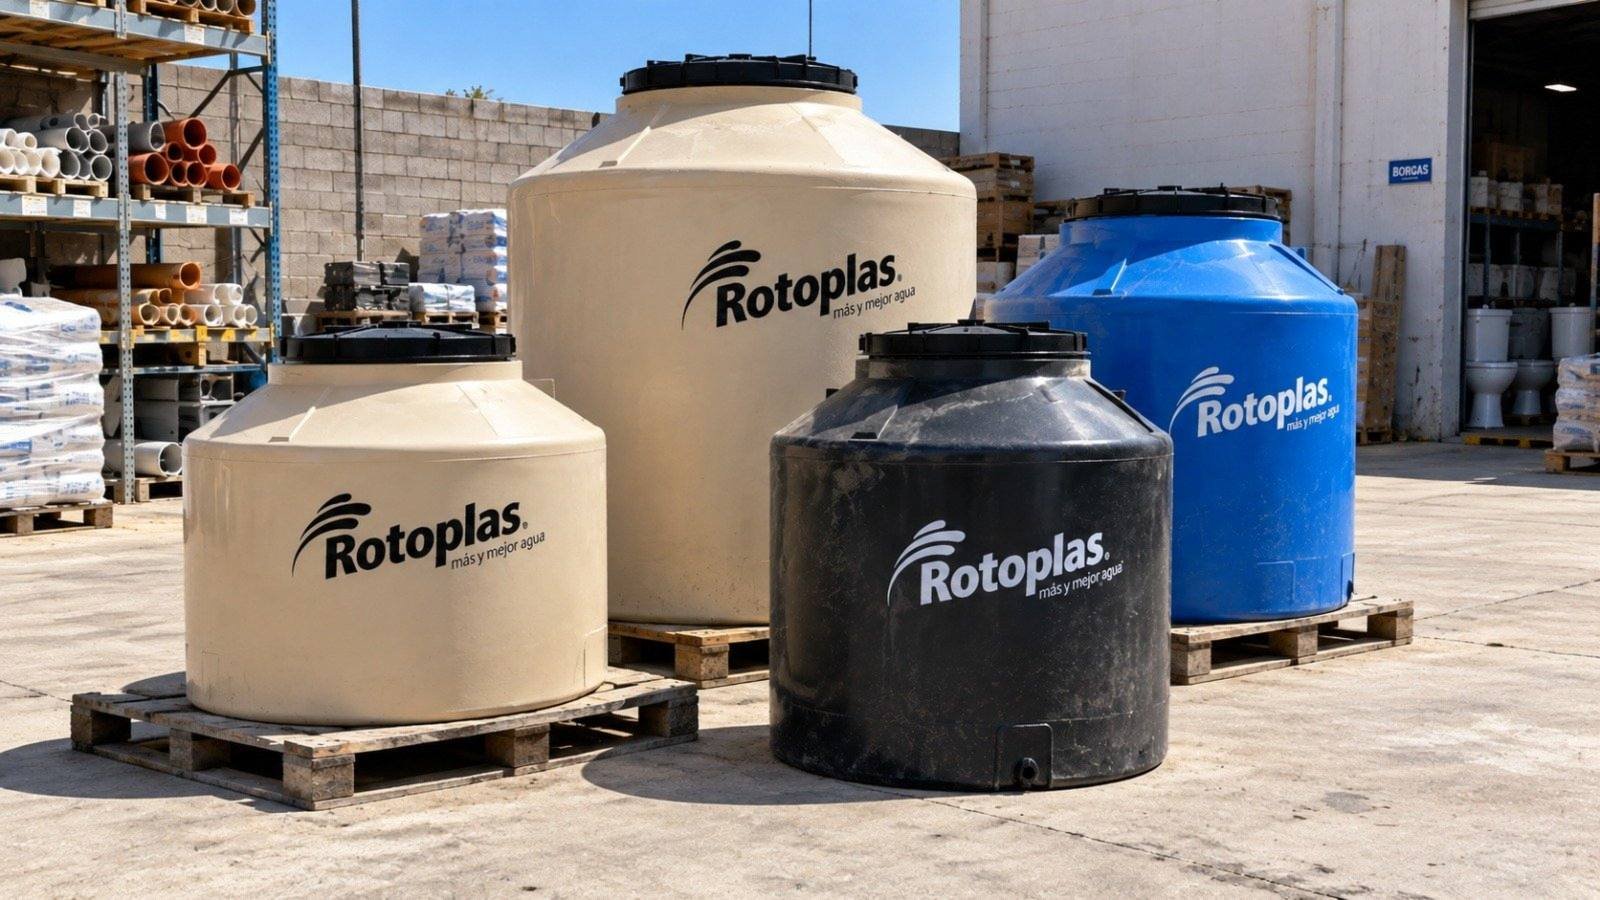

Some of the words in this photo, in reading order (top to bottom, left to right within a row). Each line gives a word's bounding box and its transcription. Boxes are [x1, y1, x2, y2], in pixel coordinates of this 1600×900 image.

[716, 253, 896, 328] Rotoplas
[833, 303, 855, 319] más
[865, 294, 893, 310] mejor
[894, 286, 916, 303] agua
[1197, 376, 1329, 438] Rotoplas
[325, 502, 521, 580] Rotoplas
[451, 553, 476, 570] más
[477, 551, 485, 565] y
[487, 541, 518, 558] mejor
[520, 532, 545, 550] agua
[920, 532, 1103, 606] Rotoplas
[1039, 582, 1063, 600] más
[1063, 582, 1071, 596] y
[1072, 572, 1101, 589] mejor
[1101, 564, 1124, 581] agua
